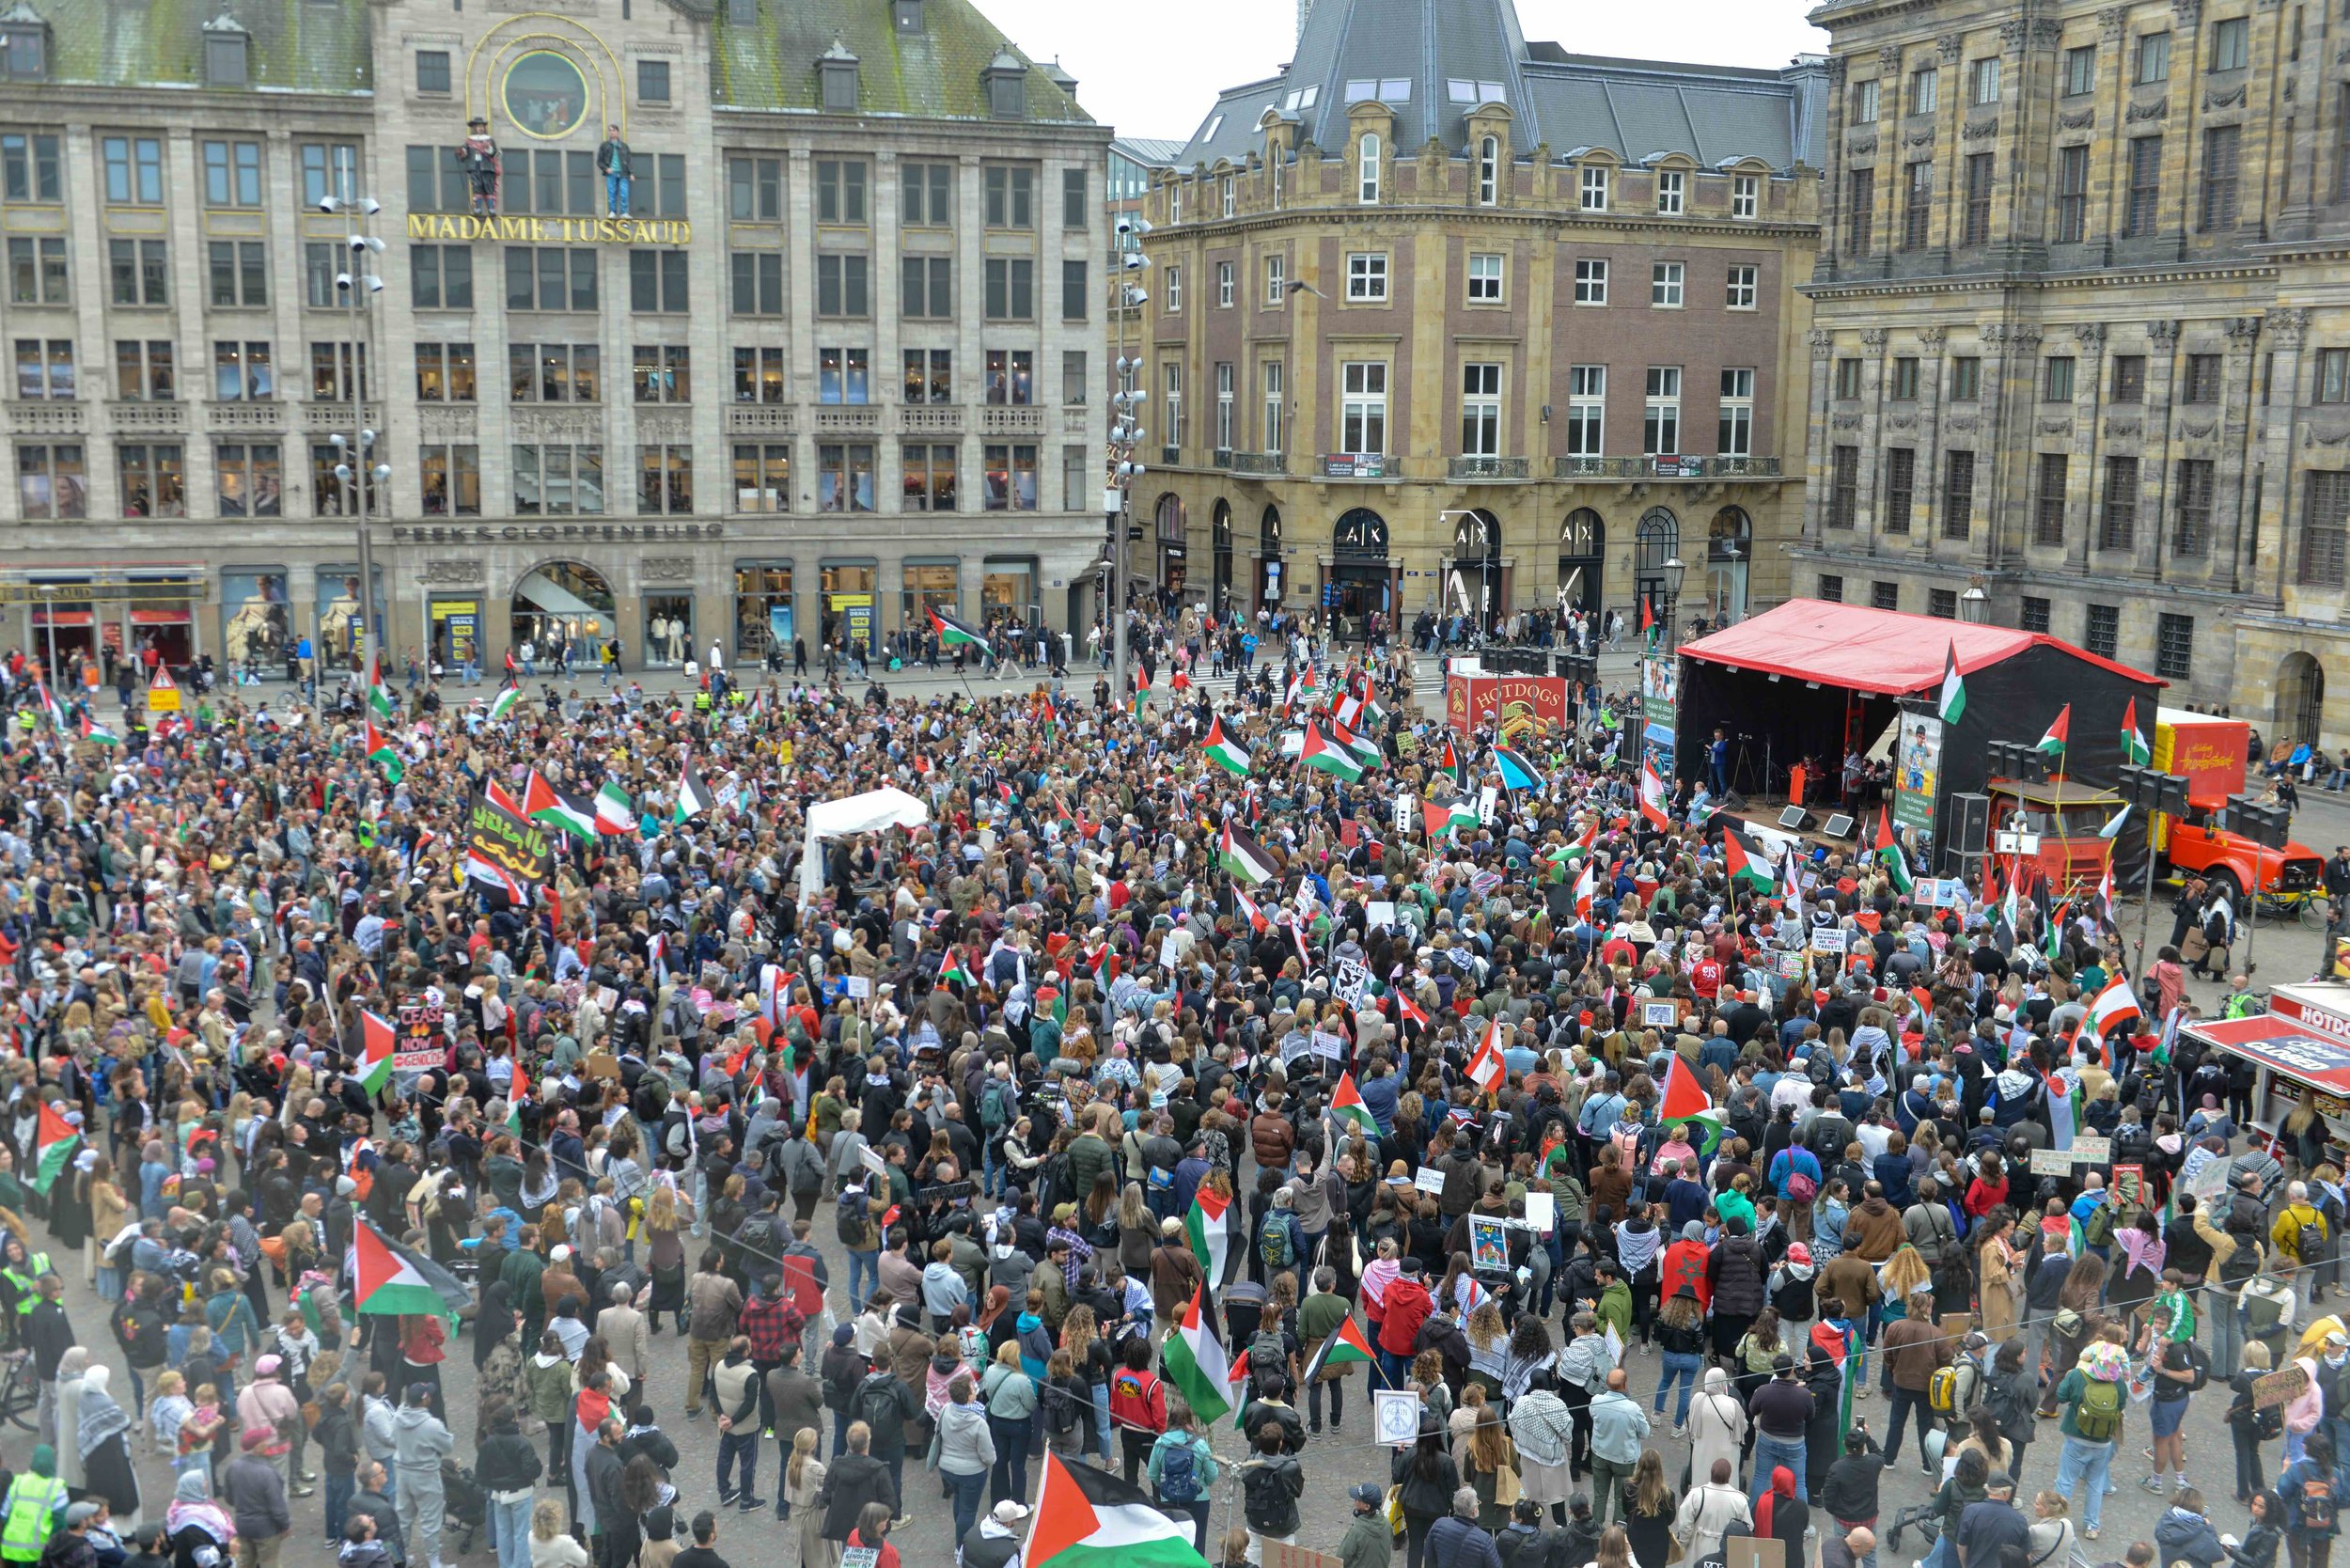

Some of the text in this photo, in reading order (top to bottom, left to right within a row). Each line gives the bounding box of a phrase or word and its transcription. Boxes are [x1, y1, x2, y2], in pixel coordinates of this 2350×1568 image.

[407, 214, 691, 243] MADAME TUSSAUD
[392, 526, 467, 541] PEEK
[501, 524, 725, 541] CLOPPENBURG
[1476, 683, 1561, 709] HOTDOGS
[1343, 960, 1365, 976] PEACE
[1335, 986, 1356, 1002] NOW
[400, 1007, 445, 1026] CEASE
[404, 1051, 445, 1066] GENOCIDE
[2244, 1042, 2330, 1071] CLOSED
[1386, 1407, 1408, 1416] AGAIN
